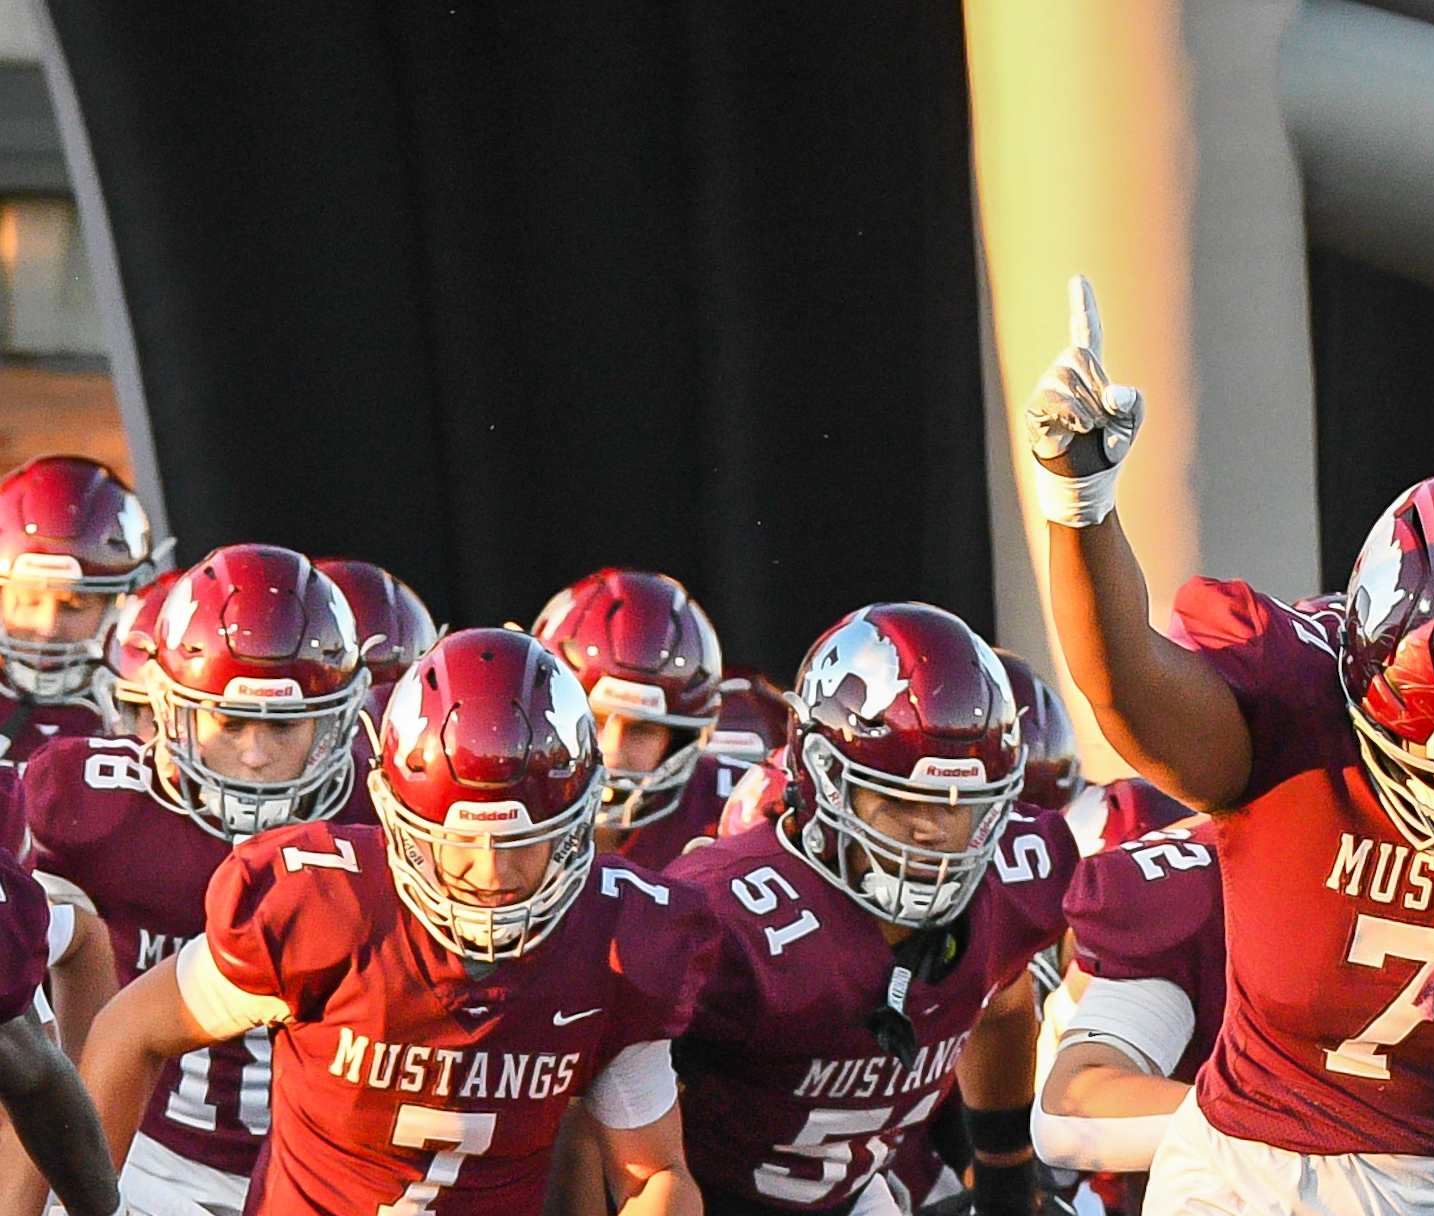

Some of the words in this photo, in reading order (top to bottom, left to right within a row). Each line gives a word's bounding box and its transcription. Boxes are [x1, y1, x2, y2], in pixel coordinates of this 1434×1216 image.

[458, 808, 519, 821] Riddell
[280, 838, 361, 876] 7
[601, 865, 670, 905] 7
[731, 866, 820, 955] 51
[328, 1026, 581, 1100] MUSTANGS
